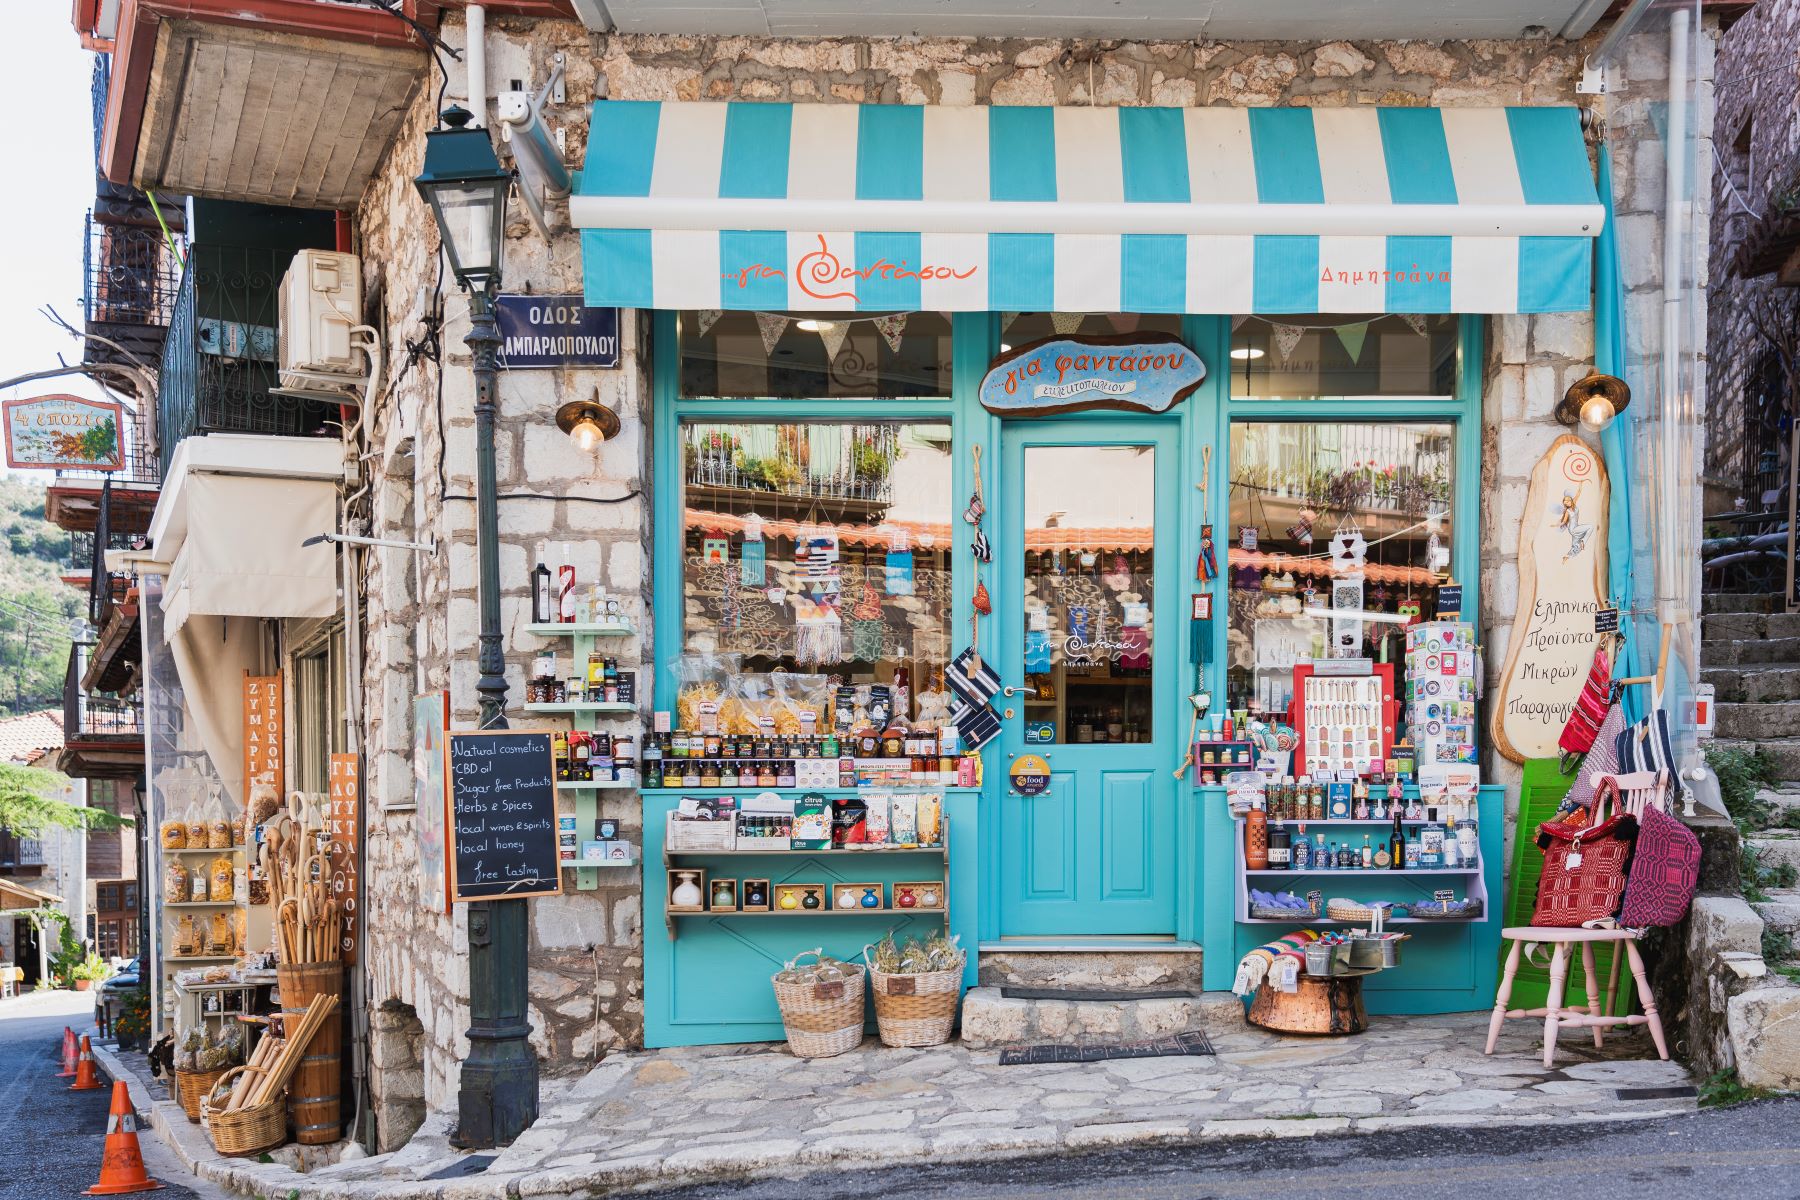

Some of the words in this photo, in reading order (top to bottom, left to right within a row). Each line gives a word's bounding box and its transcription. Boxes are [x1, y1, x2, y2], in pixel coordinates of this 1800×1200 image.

[1321, 262, 1451, 286] Δημητσάνα
[529, 306, 581, 325] ΟΔΟΣ
[1520, 660, 1578, 684] Μικρών
[499, 739, 545, 755] cosmetics
[480, 761, 492, 774] oil
[494, 778, 512, 793] free
[515, 776, 552, 790] Products
[1026, 776, 1044, 784] food
[332, 761, 343, 854] ΓΛΥΚΑ
[491, 802, 499, 811] &
[502, 799, 533, 812] Spices
[345, 761, 357, 931] ΚΟΥΤΑΛΙΟΥ
[496, 837, 525, 854] honey
[474, 859, 499, 883] free
